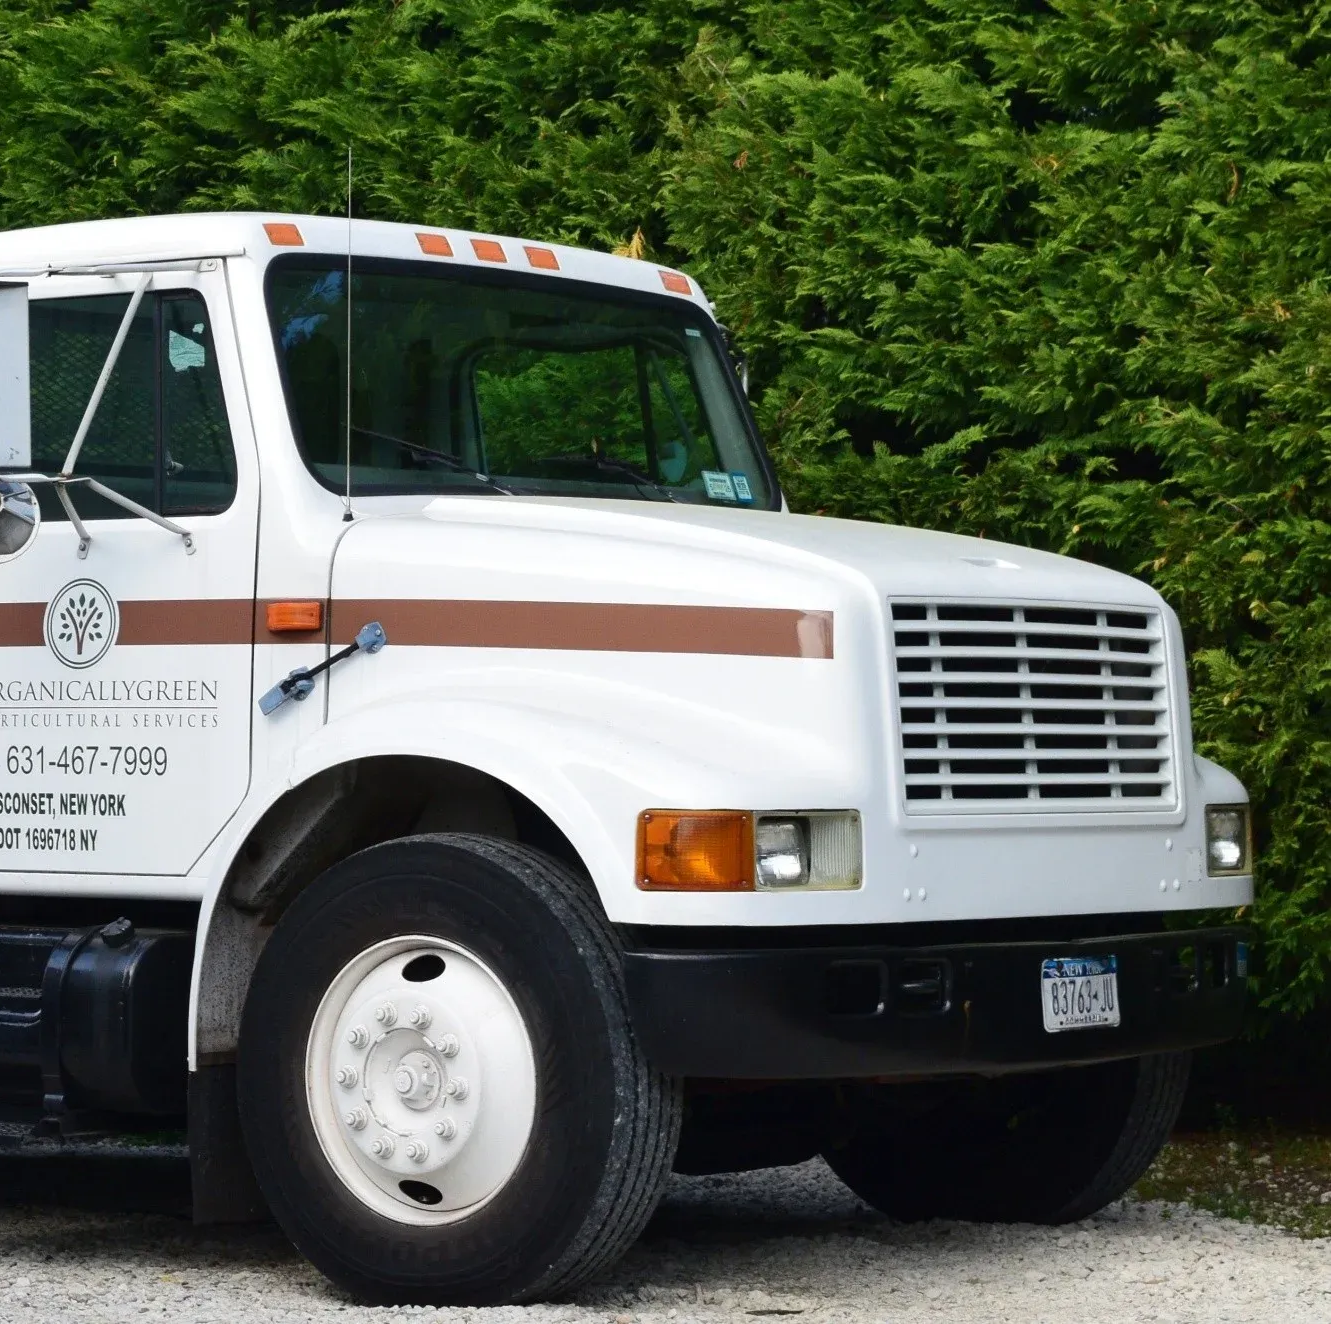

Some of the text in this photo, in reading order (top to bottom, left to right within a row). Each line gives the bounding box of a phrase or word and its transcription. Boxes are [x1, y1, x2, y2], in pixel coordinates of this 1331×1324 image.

[132, 713, 218, 728] SERVICES
[6, 744, 168, 776] 631-467-7999
[59, 792, 88, 816] NEW
[89, 793, 127, 817] YORK
[25, 827, 77, 851] 1696718
[79, 828, 98, 852] NY
[1062, 963, 1083, 977] NEW
